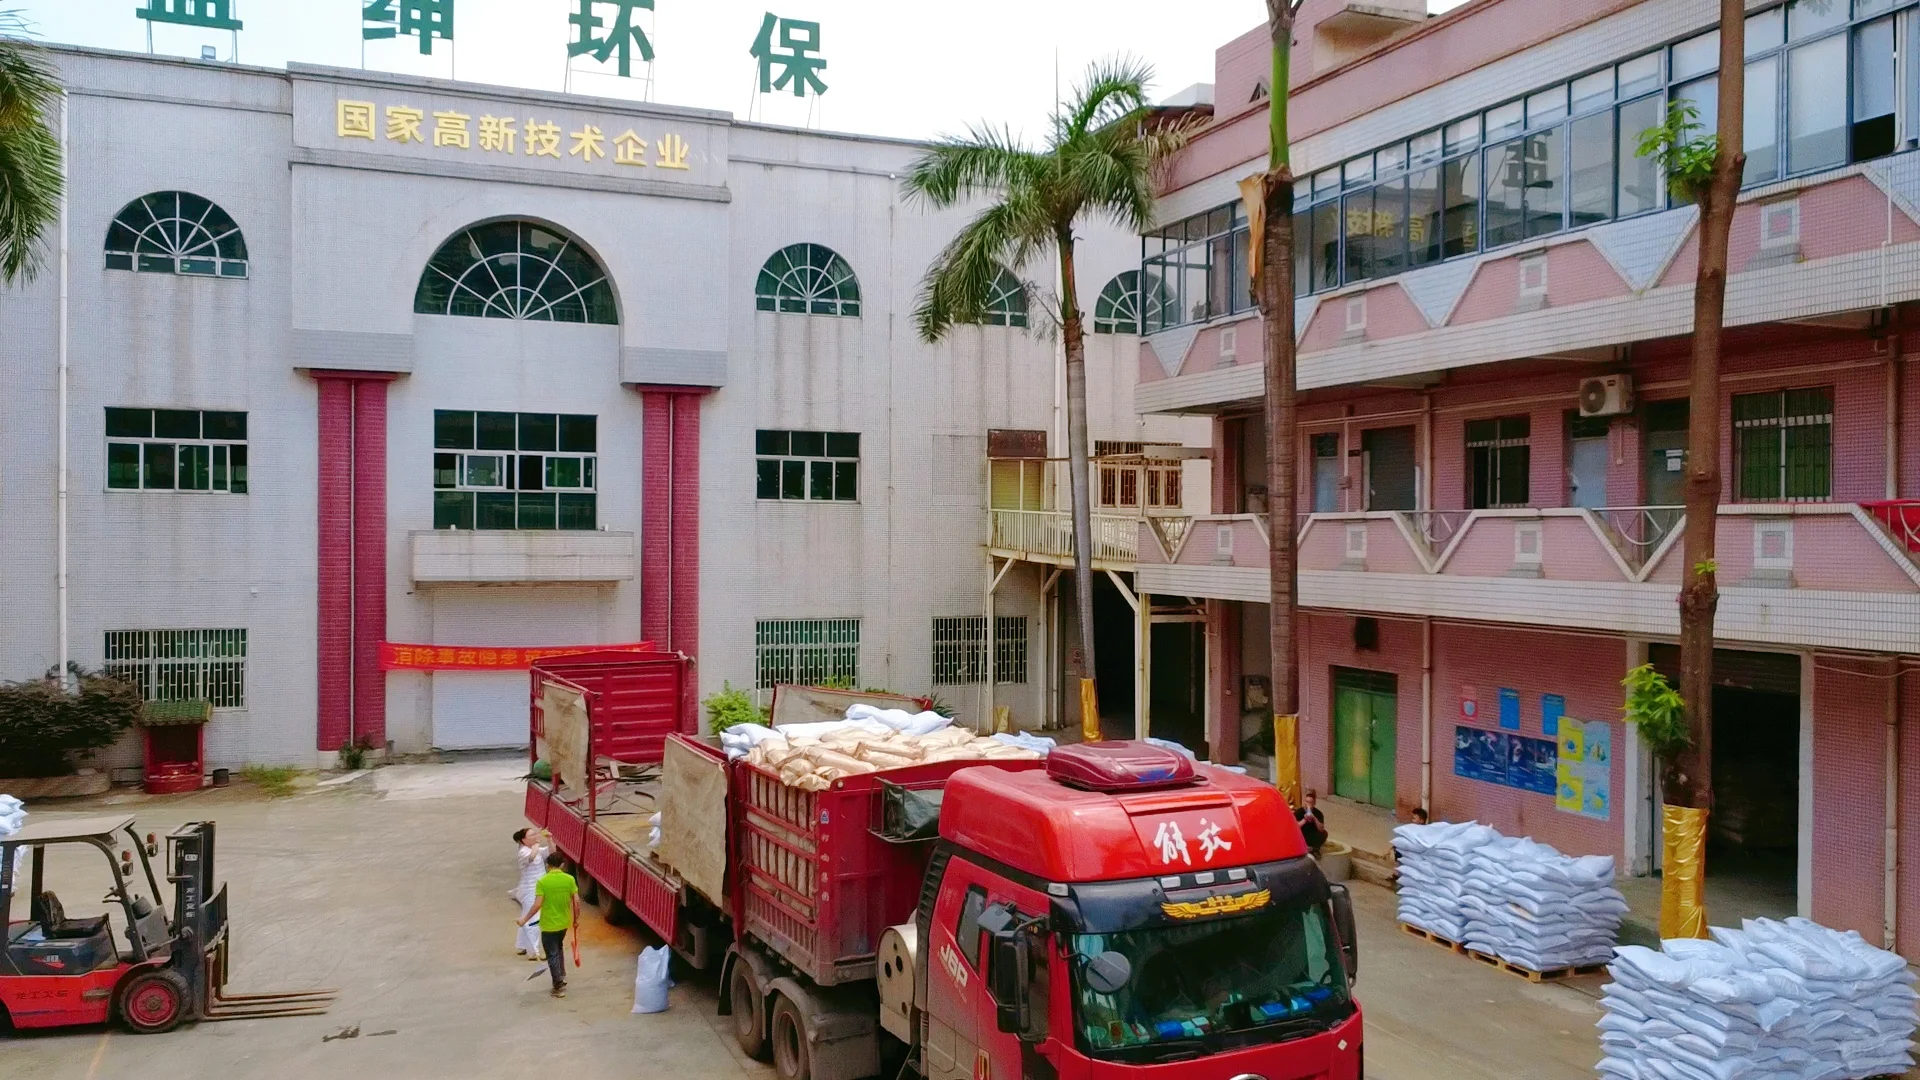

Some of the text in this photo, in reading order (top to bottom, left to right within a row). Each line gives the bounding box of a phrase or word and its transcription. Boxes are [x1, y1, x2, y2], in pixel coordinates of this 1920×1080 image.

[336, 100, 692, 171] 国家高新技术企业
[394, 646, 518, 665] 消除事故隐患
[1153, 817, 1232, 866] 解放
